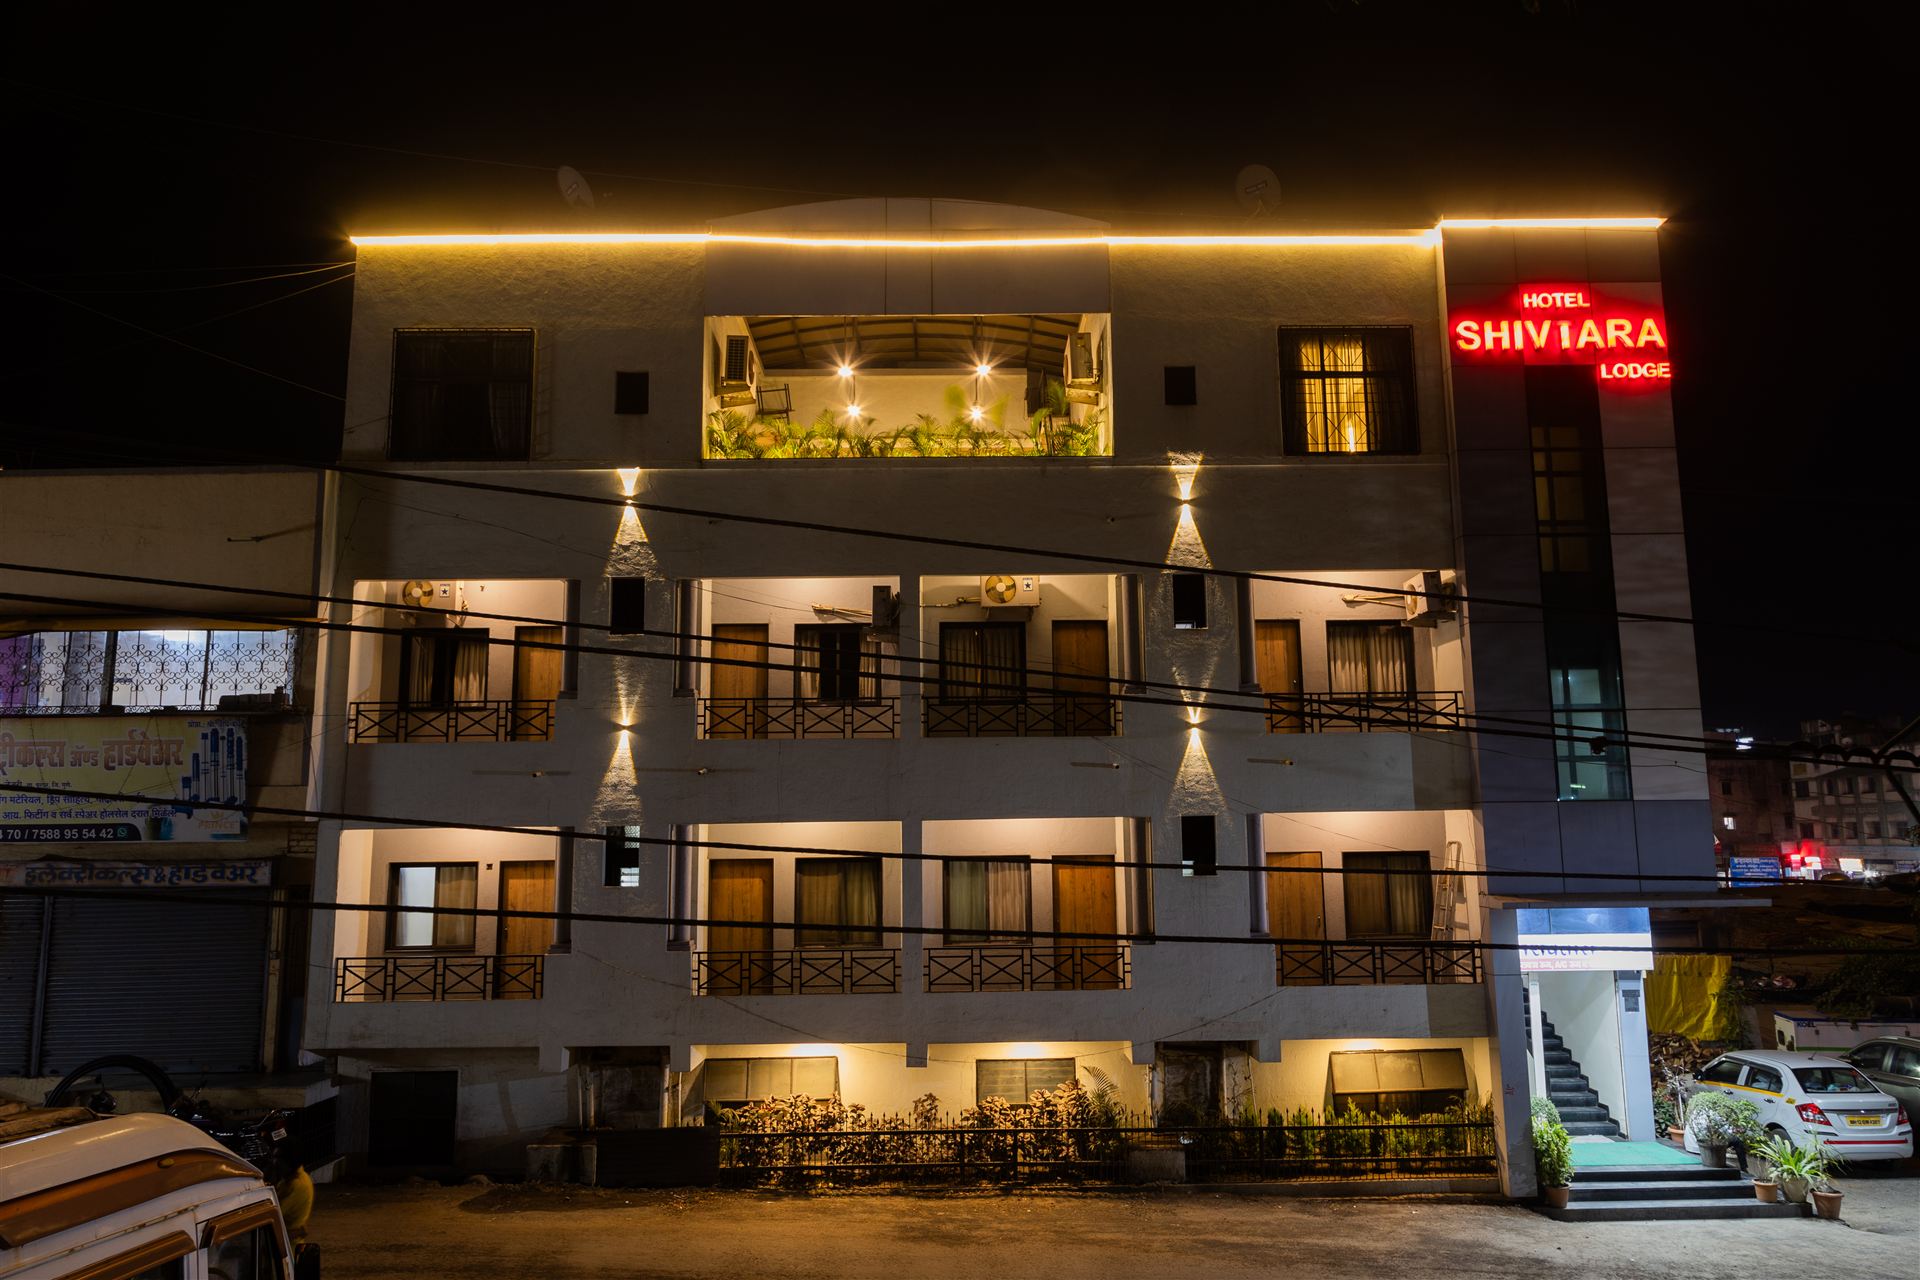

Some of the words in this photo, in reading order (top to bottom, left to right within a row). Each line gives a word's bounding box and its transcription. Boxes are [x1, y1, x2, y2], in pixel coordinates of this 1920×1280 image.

[1522, 292, 1591, 309] HOTEL
[1455, 318, 1666, 351] SHIVTARA
[1600, 362, 1671, 379] LODGE
[7, 829, 21, 840] 70
[32, 829, 61, 840] 7588
[63, 829, 79, 839] 95
[82, 829, 96, 839] 54
[99, 828, 114, 838] 42
